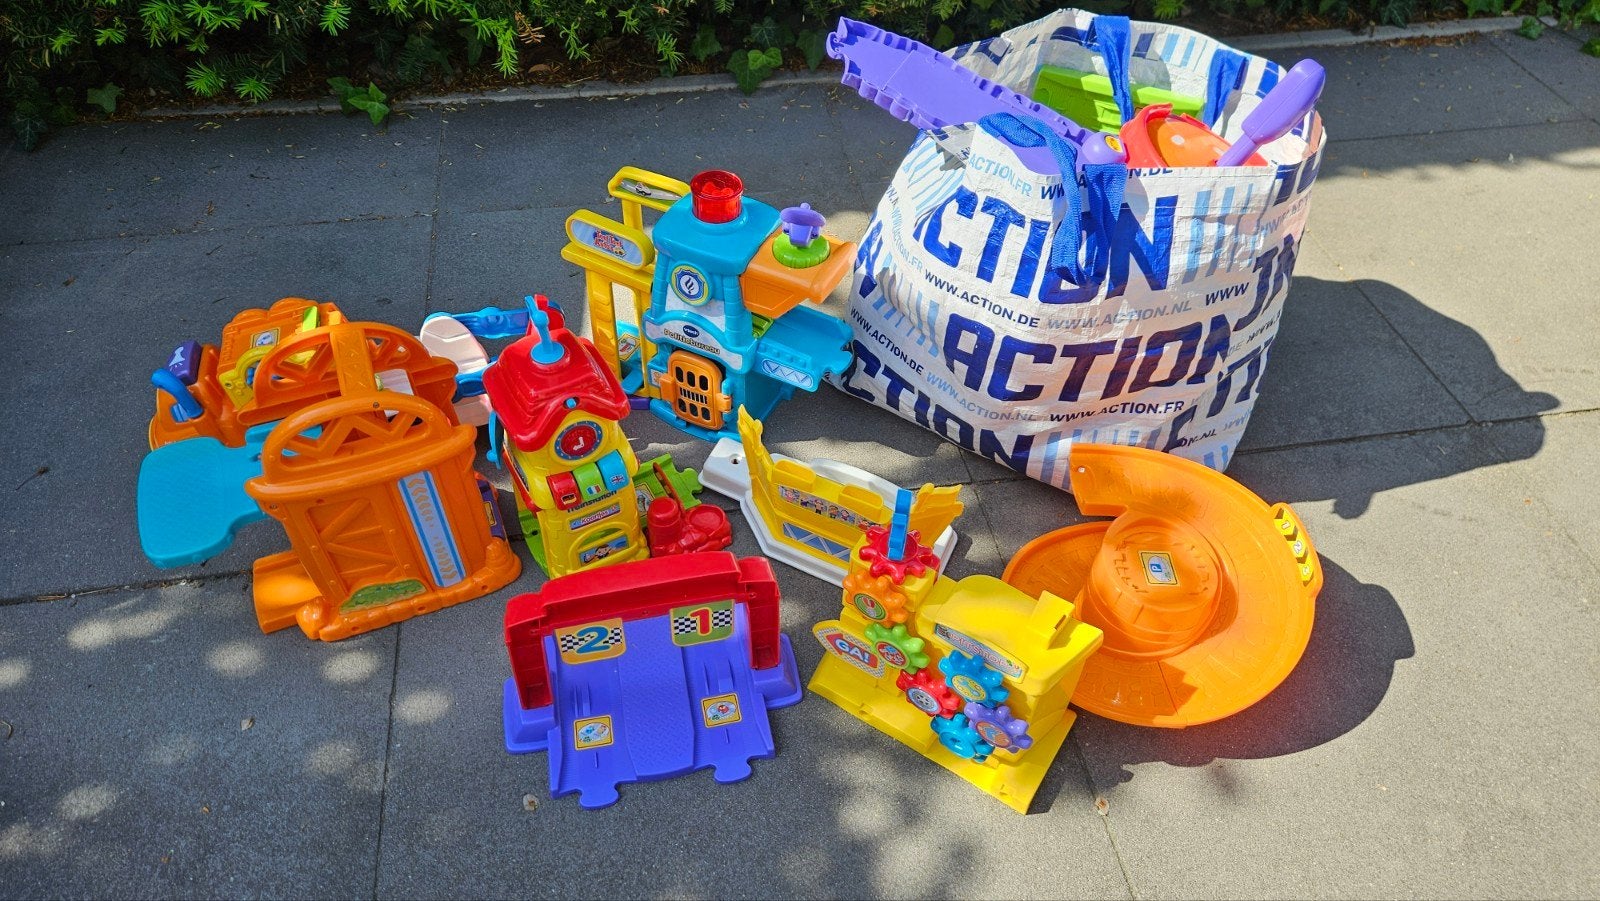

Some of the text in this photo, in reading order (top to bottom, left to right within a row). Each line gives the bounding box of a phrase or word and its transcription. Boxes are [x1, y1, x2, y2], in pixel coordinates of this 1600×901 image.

[925, 268, 1041, 329] WWW.ACTION.DE
[1047, 299, 1192, 330] WWW.ACTION.NL
[850, 306, 924, 376] WWW.ACTION.DE
[942, 312, 1231, 403] ACTION
[926, 371, 1037, 421] WWW.ACTION.NL
[1050, 401, 1185, 422] WWW.ACTION.FR
[690, 607, 713, 636] 1
[575, 626, 611, 654] 2
[835, 638, 870, 663] GA!
